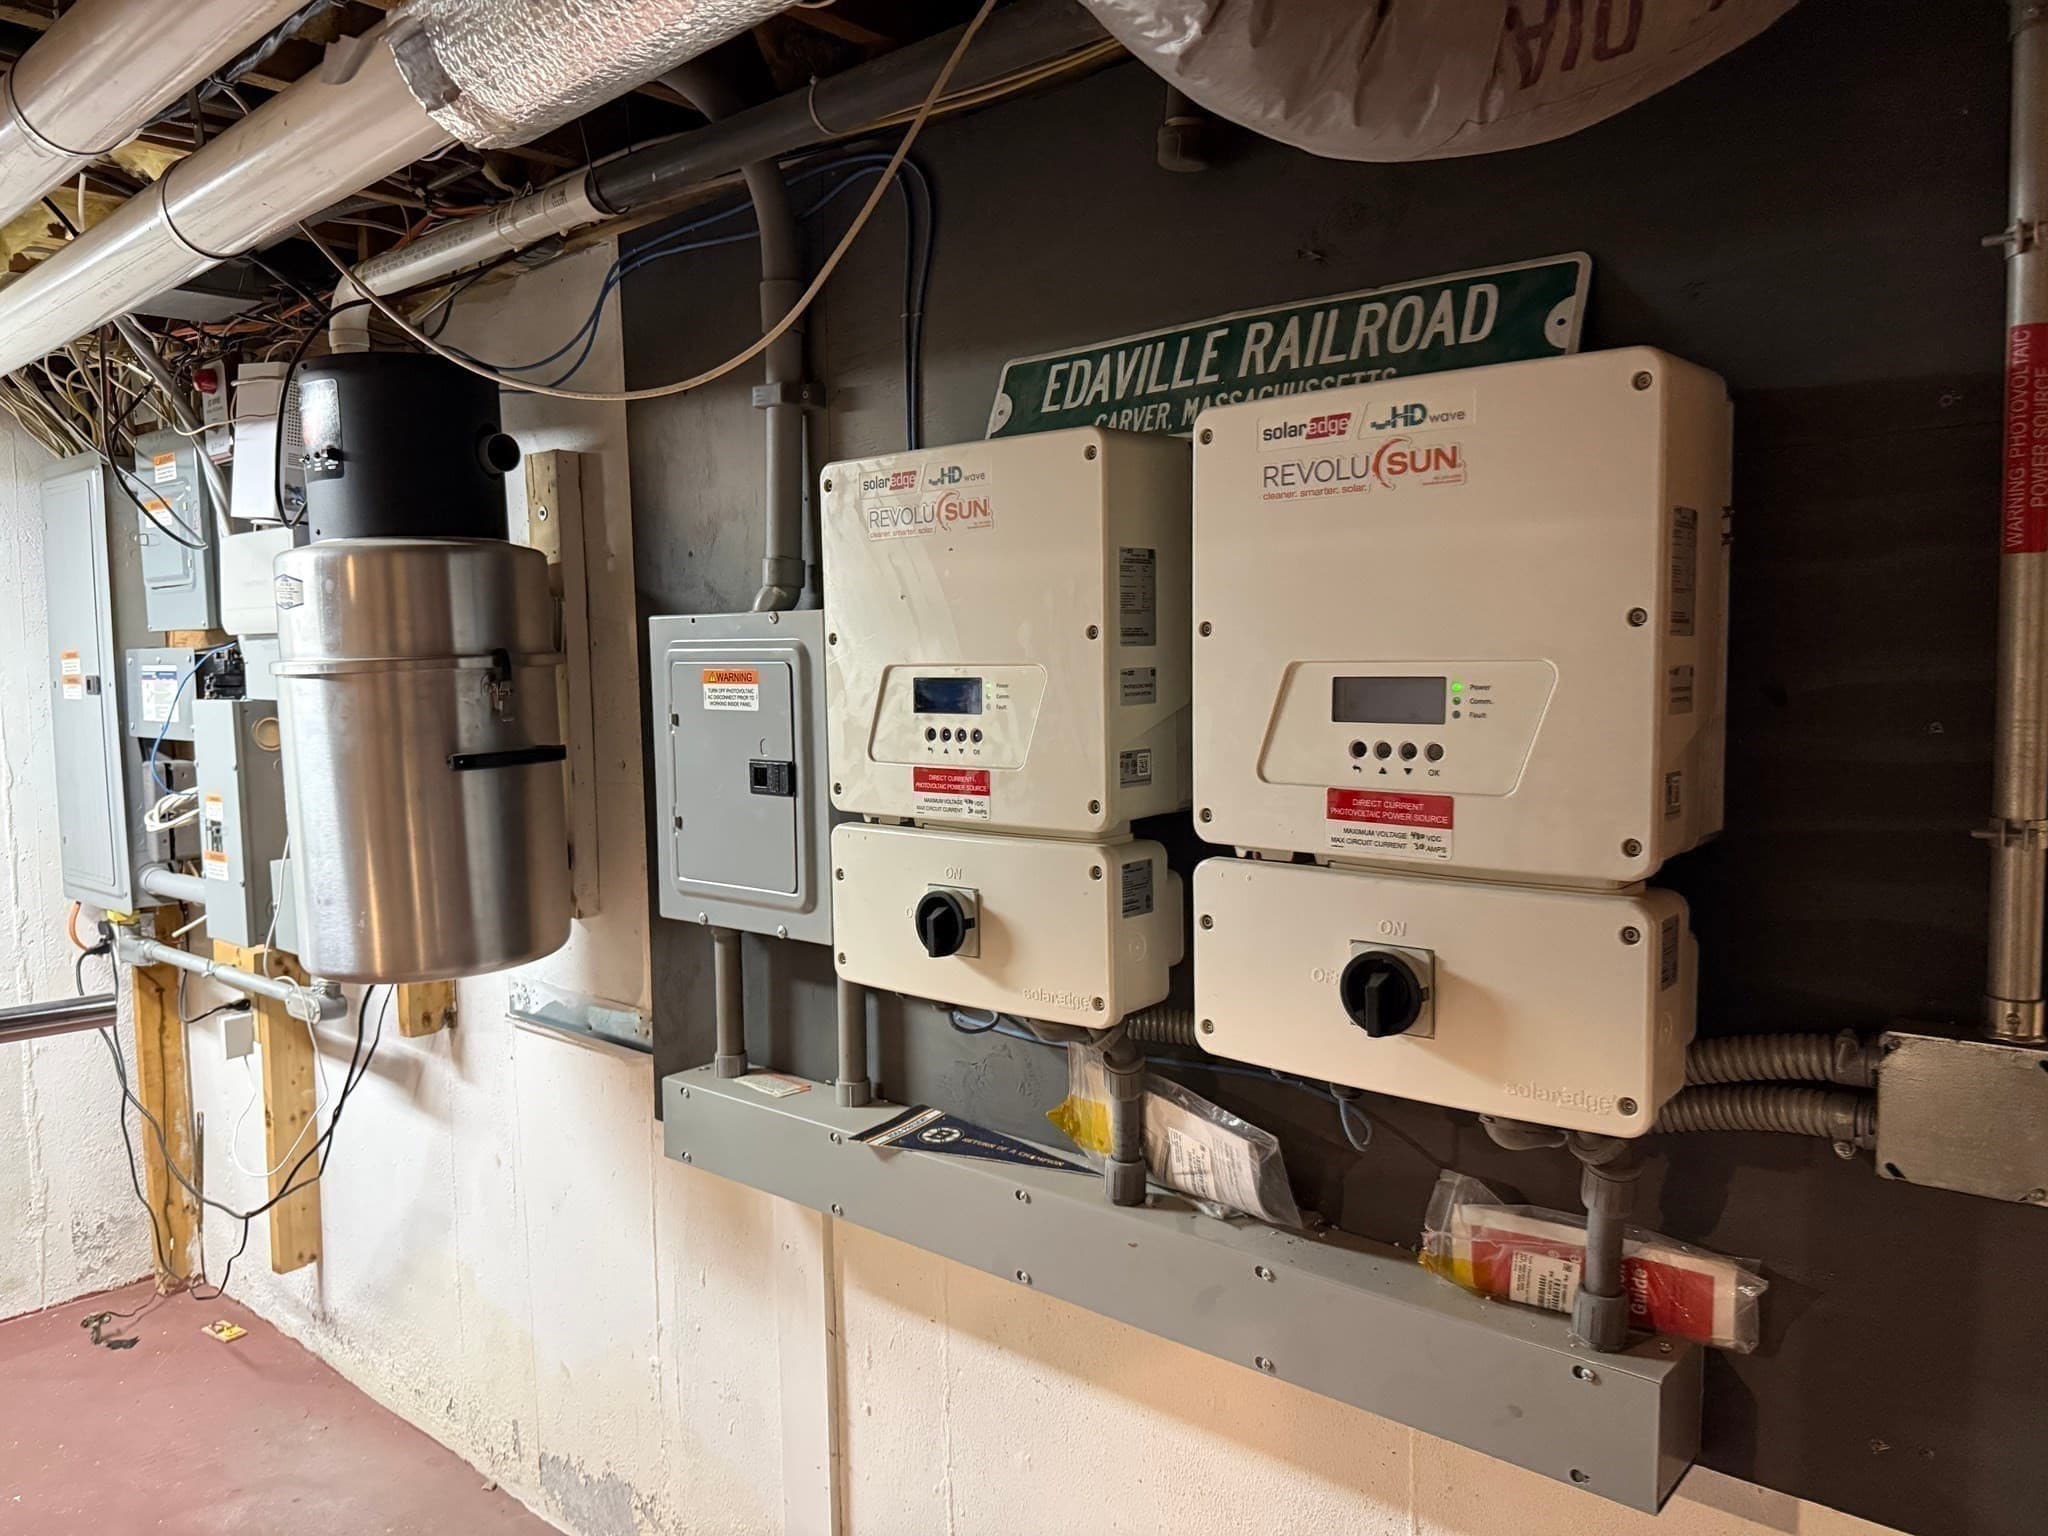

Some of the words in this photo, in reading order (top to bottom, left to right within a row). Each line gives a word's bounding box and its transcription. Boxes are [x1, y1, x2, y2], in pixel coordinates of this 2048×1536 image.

[1041, 328, 1230, 413] EDAVILLE
[1237, 283, 1498, 379] RAILROAD
[2008, 330, 2032, 459] PHOTOVOLTAIC
[2032, 366, 2048, 445] SOURCE
[1429, 409, 1466, 424] wave
[1263, 412, 1351, 442] solaredge
[863, 470, 917, 491] solaredge
[964, 472, 985, 482] wave
[2030, 449, 2048, 508] POWER
[716, 672, 753, 682] WARNING
[1469, 684, 1491, 692] Power
[1352, 798, 1382, 808] DIRECT
[1383, 801, 1424, 811] CURRENT
[1330, 807, 1381, 819] PHOTOVOLTAIC
[1382, 811, 1412, 821] POWER
[1414, 814, 1449, 824] SOURCE
[1343, 827, 1375, 837] MAXIMUM
[1375, 830, 1407, 840] VOLTAGE
[1345, 838, 1373, 847] CIRCUIT
[1374, 840, 1408, 850] CURRENT
[1426, 846, 1447, 854] AMPS
[945, 868, 962, 880] ON
[1380, 919, 1408, 937] ON
[1312, 967, 1339, 985] OF
[1631, 1268, 1649, 1315] Guide
